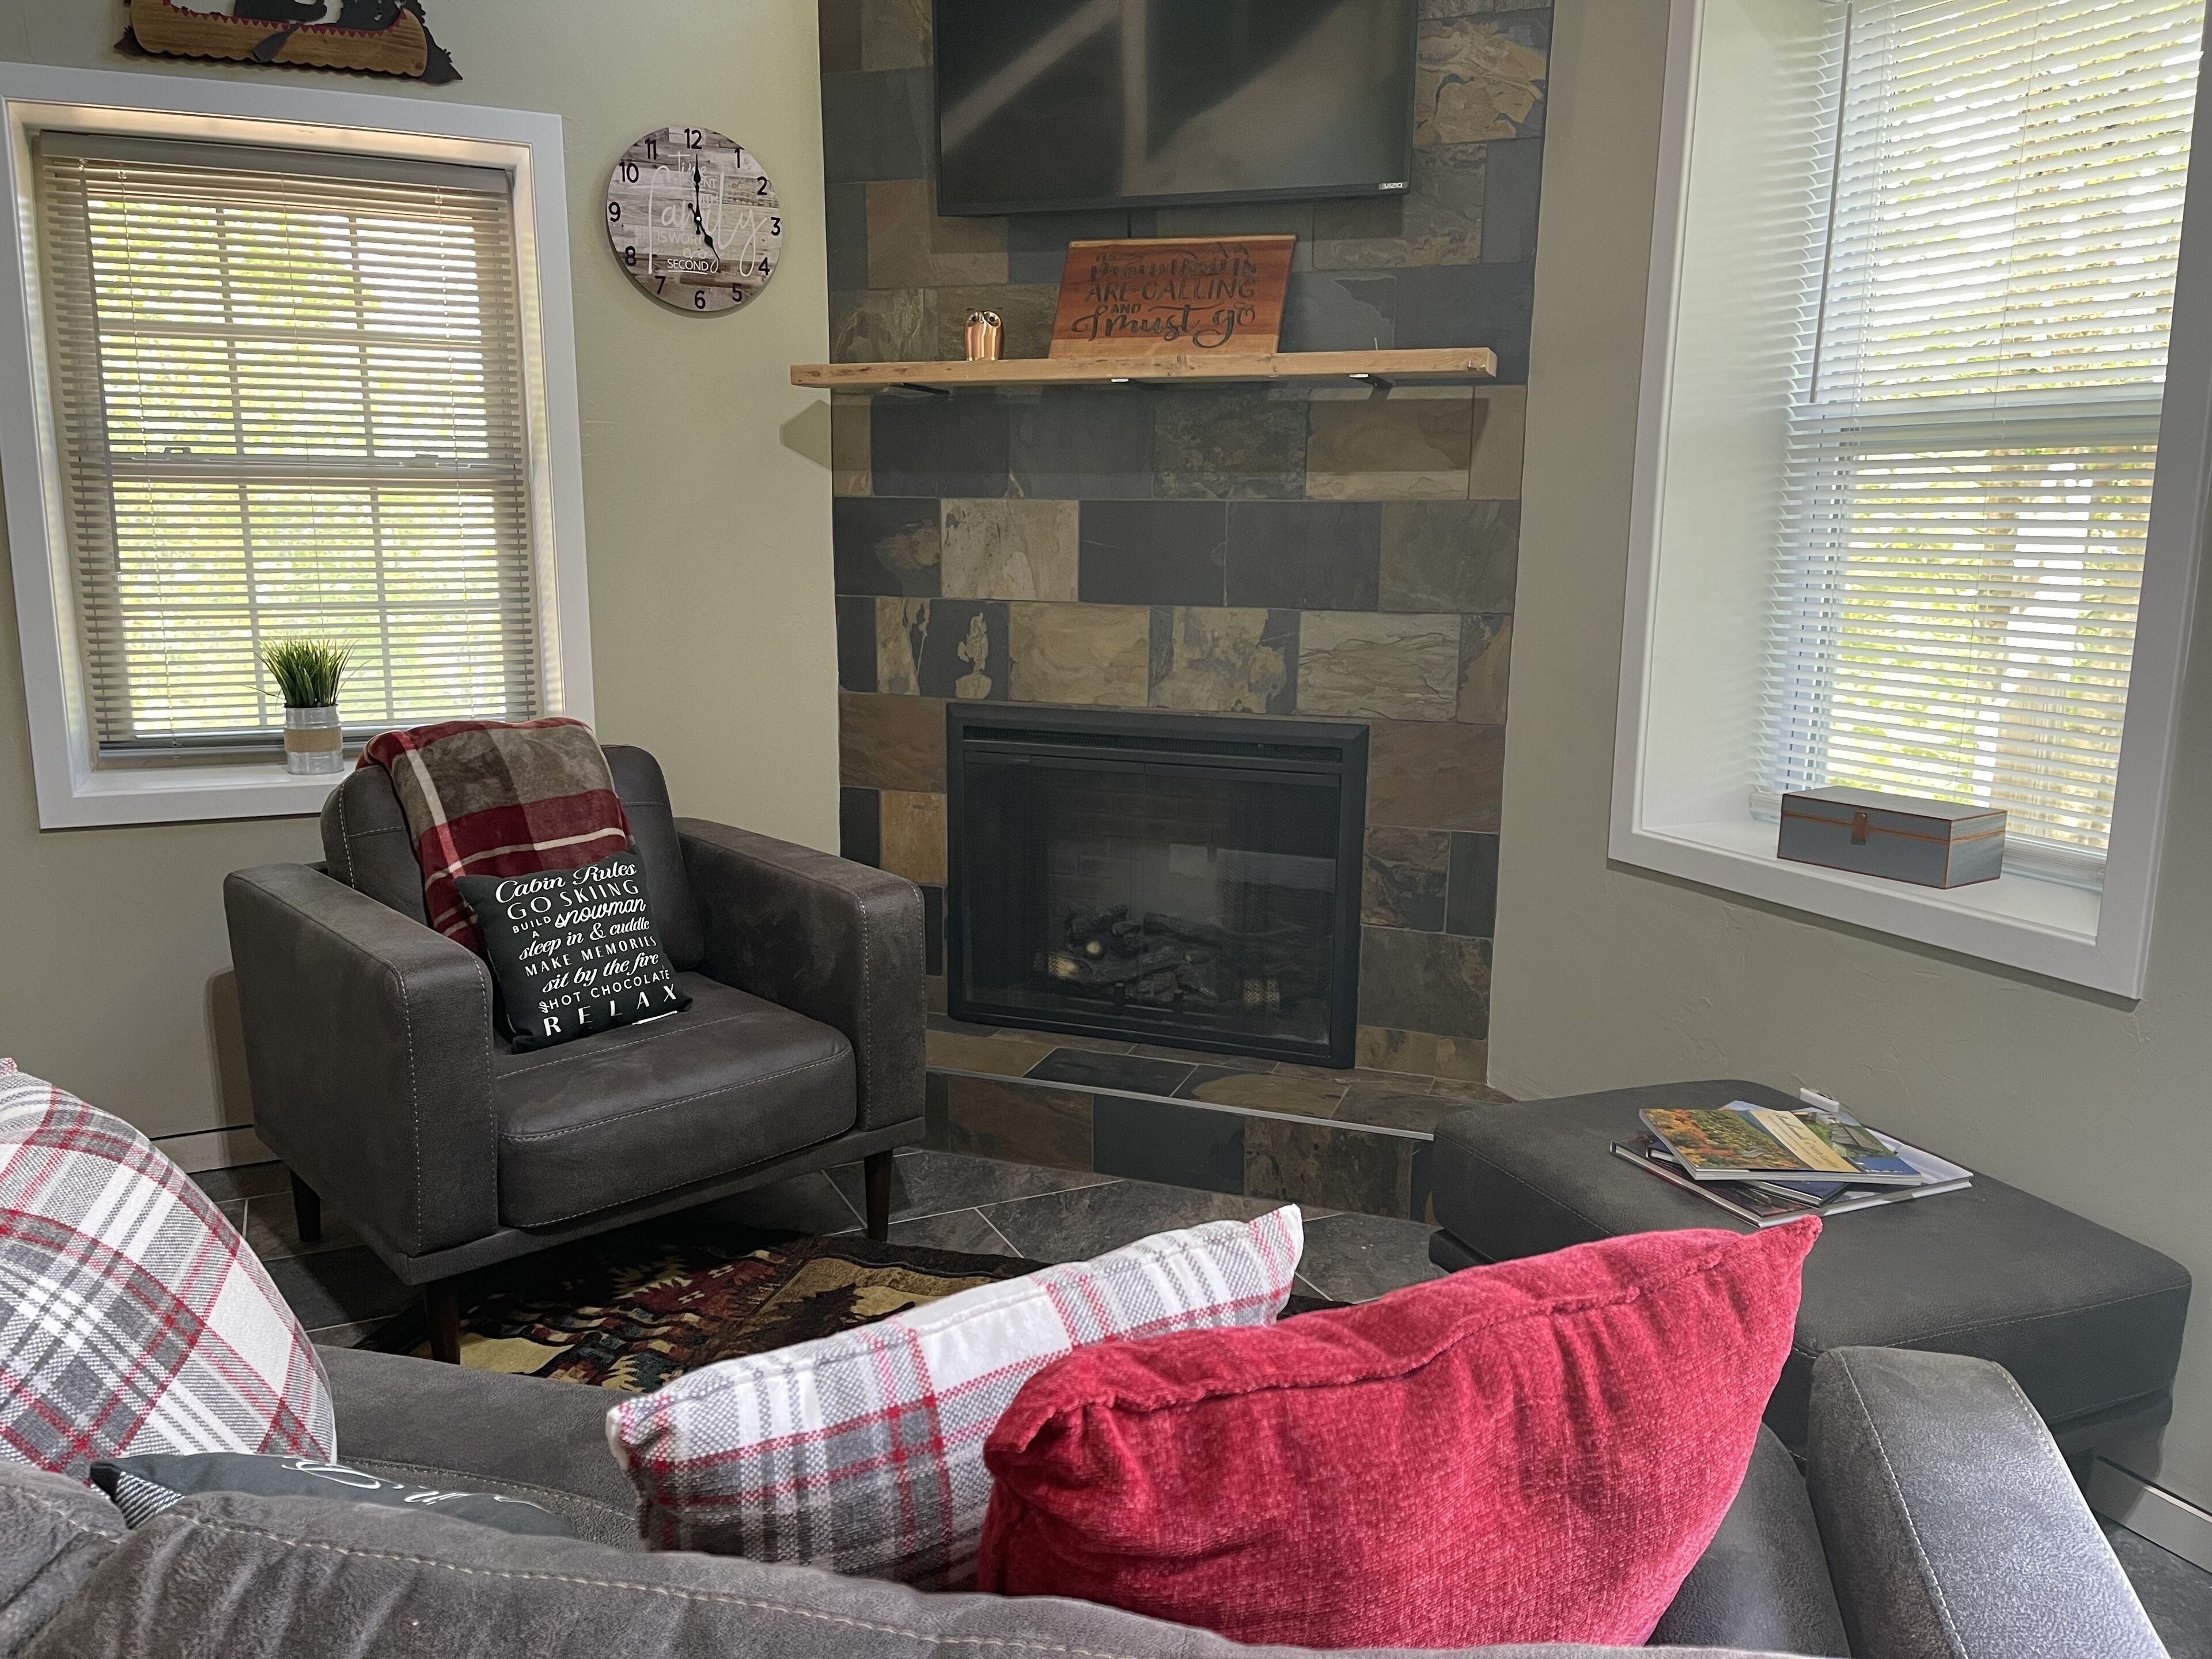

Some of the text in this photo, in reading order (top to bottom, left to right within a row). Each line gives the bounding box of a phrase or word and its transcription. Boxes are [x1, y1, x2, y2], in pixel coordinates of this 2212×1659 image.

[645, 138, 657, 160] 11
[684, 128, 702, 149] 12
[734, 149, 740, 168] 1
[619, 162, 639, 183] 10
[757, 176, 768, 195] 2
[608, 202, 620, 222] 9
[771, 217, 781, 236] 3
[625, 245, 637, 266] 8
[667, 259, 709, 271] SECOND
[759, 257, 770, 275] 4
[654, 275, 666, 294] 7
[732, 283, 742, 302] 5
[1084, 276, 1256, 302] ARE CALLING
[695, 290, 706, 309] 6
[495, 862, 637, 903] Cabin Rules
[507, 880, 639, 920] GO SKIING
[512, 898, 646, 939] BUILD A snowman
[519, 916, 650, 961] sleep in & cuddle
[525, 935, 657, 977] MAKE MEMORIES
[541, 952, 659, 993] sit by the fire
[549, 991, 581, 1010] HOT
[590, 969, 671, 998] CHOCOLATE
[543, 983, 677, 1036] RELAX
